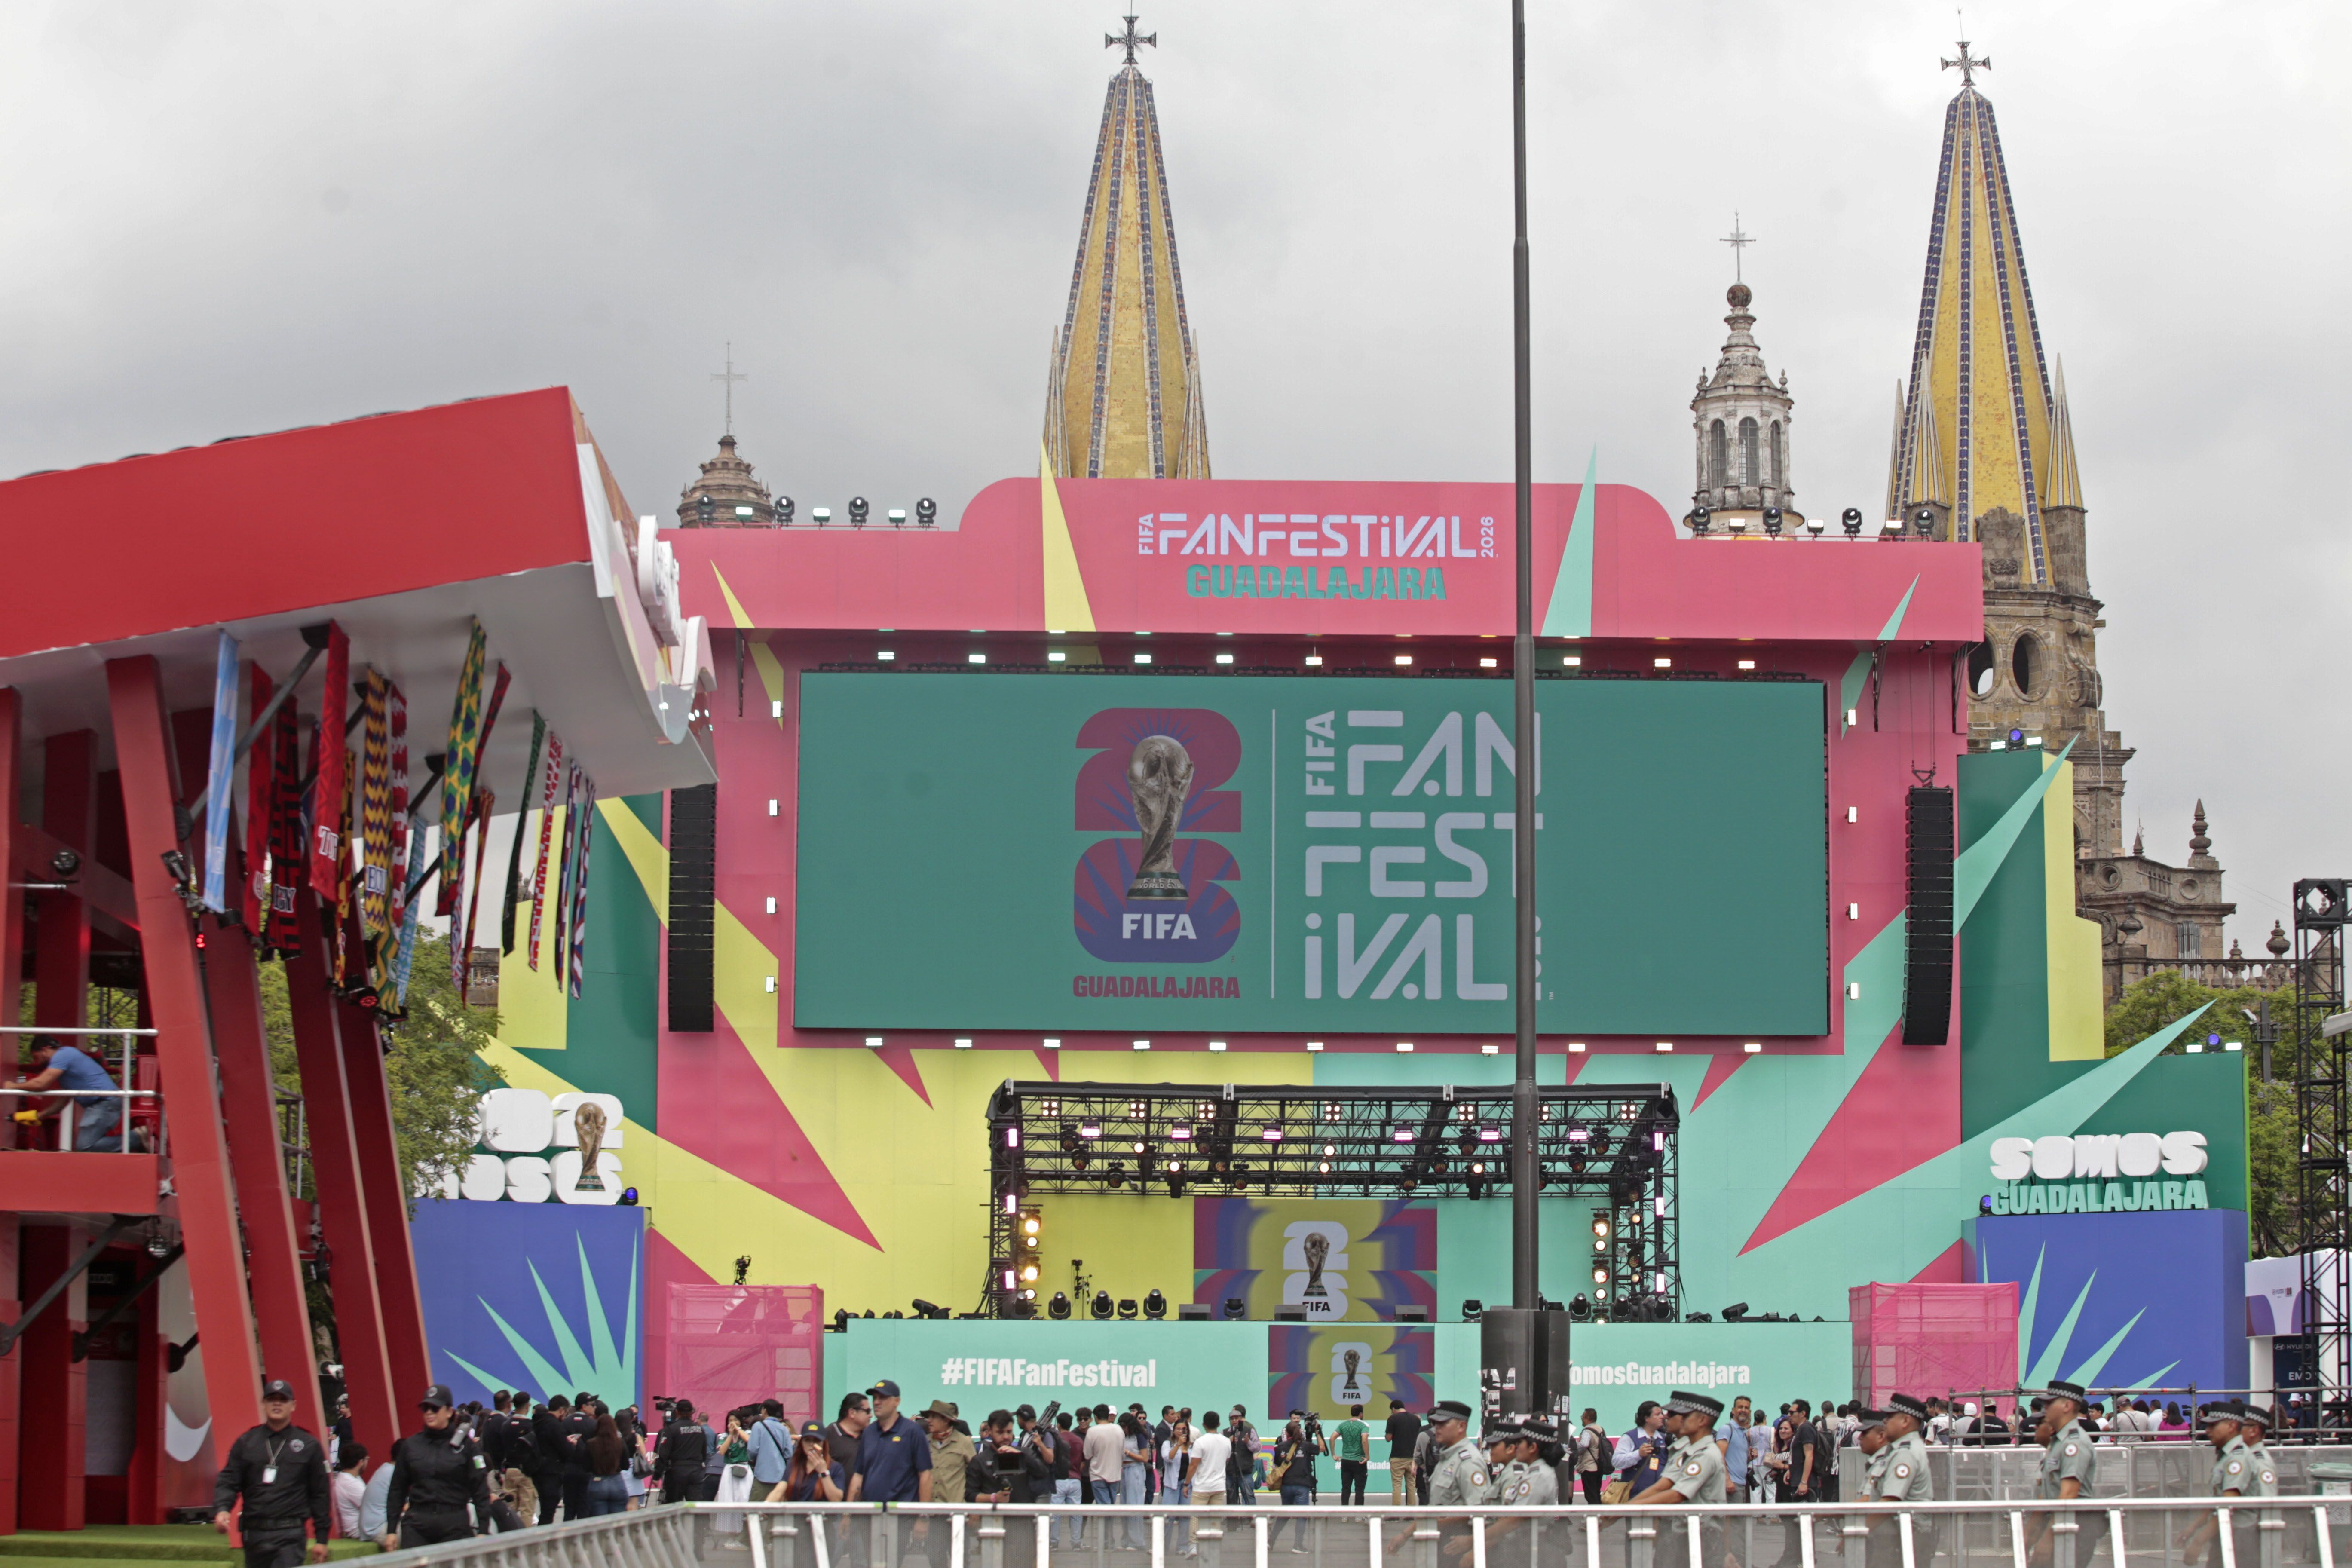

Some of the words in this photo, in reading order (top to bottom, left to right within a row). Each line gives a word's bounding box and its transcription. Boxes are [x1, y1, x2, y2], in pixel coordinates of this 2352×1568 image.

[1139, 513, 1154, 555] FIFA
[1481, 516, 1494, 558] 2026
[1186, 564, 1446, 600] GUADALAJARA
[1305, 710, 1335, 795] FIFA
[1348, 710, 1541, 796] FAN
[1122, 913, 1197, 939] FIFA
[1073, 975, 1240, 998] GUADALAJARA
[1990, 1131, 2208, 1180] SOMOS
[1991, 1180, 2208, 1215] GUADALAJARA
[941, 1358, 1156, 1387] #FIFAFanFestival
[1570, 1360, 1750, 1389] omosGuadalajara
